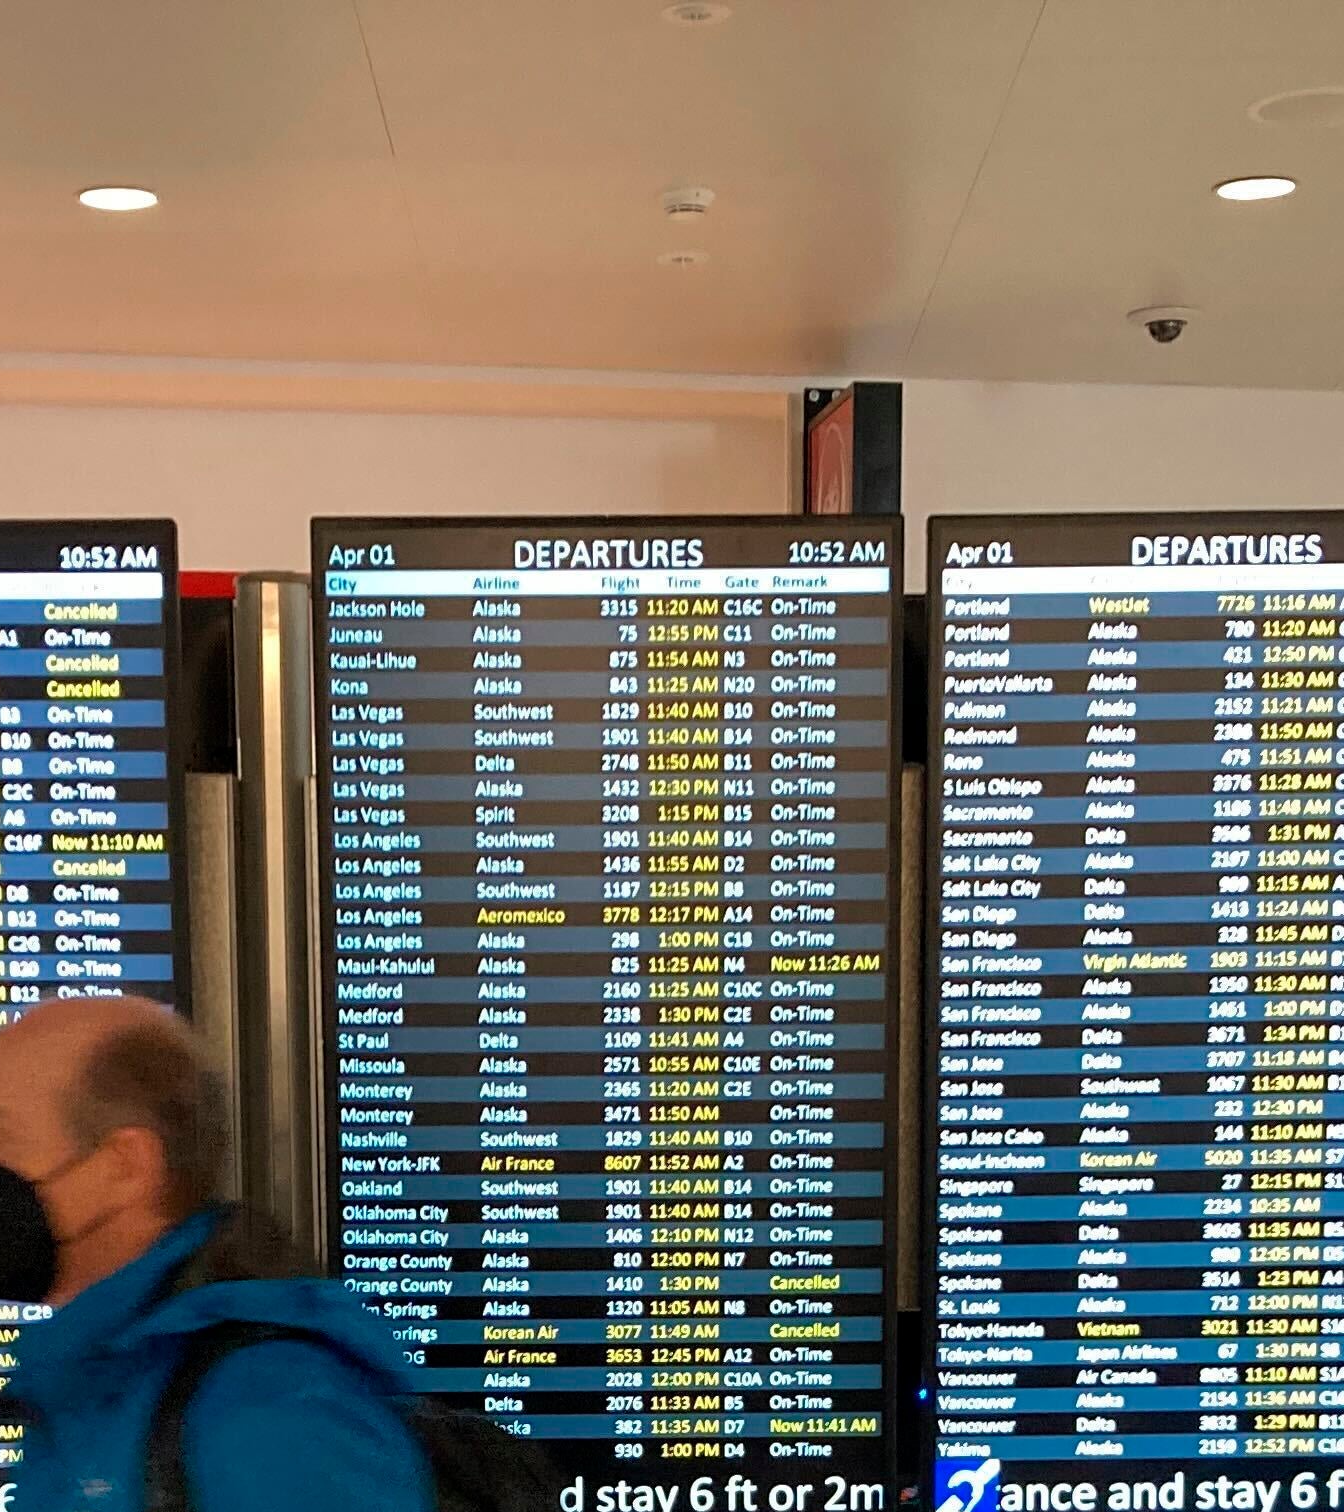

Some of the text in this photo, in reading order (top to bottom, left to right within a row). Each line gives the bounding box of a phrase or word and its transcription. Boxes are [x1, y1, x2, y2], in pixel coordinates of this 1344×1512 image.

[60, 547, 157, 568] 10:52 AM
[329, 545, 395, 568] Apr 01
[515, 540, 703, 568] DEPARTURES
[790, 541, 884, 562] 10:52 AM
[946, 542, 1013, 567] Apr 01
[1132, 535, 1322, 565] DEPARTURES
[328, 575, 826, 593] City Airline Flight Time Gate Remark
[329, 601, 386, 617] Jackson
[391, 600, 424, 616] Hole
[473, 600, 520, 616] Alaska
[601, 600, 638, 616] 3315
[648, 600, 688, 615] 11:20
[692, 600, 718, 615] AM
[771, 598, 836, 614] On-Time
[946, 598, 1009, 615] Portland
[1308, 594, 1335, 610] AM
[45, 629, 110, 646] On-Time
[337, 905, 834, 927] Los Angeles Aeromexico 3778 12:17 PM A14 On-Time
[338, 958, 434, 974] Maui-Kahului
[478, 957, 525, 974] Alaska
[649, 957, 689, 972] 11:25
[693, 956, 718, 972] AM
[724, 957, 745, 972] N4
[771, 956, 805, 971] Now
[809, 955, 850, 971] 11:26
[853, 955, 879, 970] AM
[342, 1154, 833, 1172] New York-JFK Air France 8607 11:52 AM A2 On-Time
[345, 1275, 839, 1295] Orange County Alaska 1410 1:30 PM Cancelled
[1077, 1322, 1139, 1336] Vietnam
[1201, 1320, 1238, 1335] 3021
[1290, 1319, 1317, 1333] AM
[690, 1477, 714, 1512] 6
[725, 1475, 757, 1511] ft
[769, 1485, 813, 1511] or
[824, 1476, 883, 1510] 2m
[996, 1483, 1096, 1511] ance
[1108, 1472, 1184, 1510] and
[1291, 1472, 1316, 1508] 6
